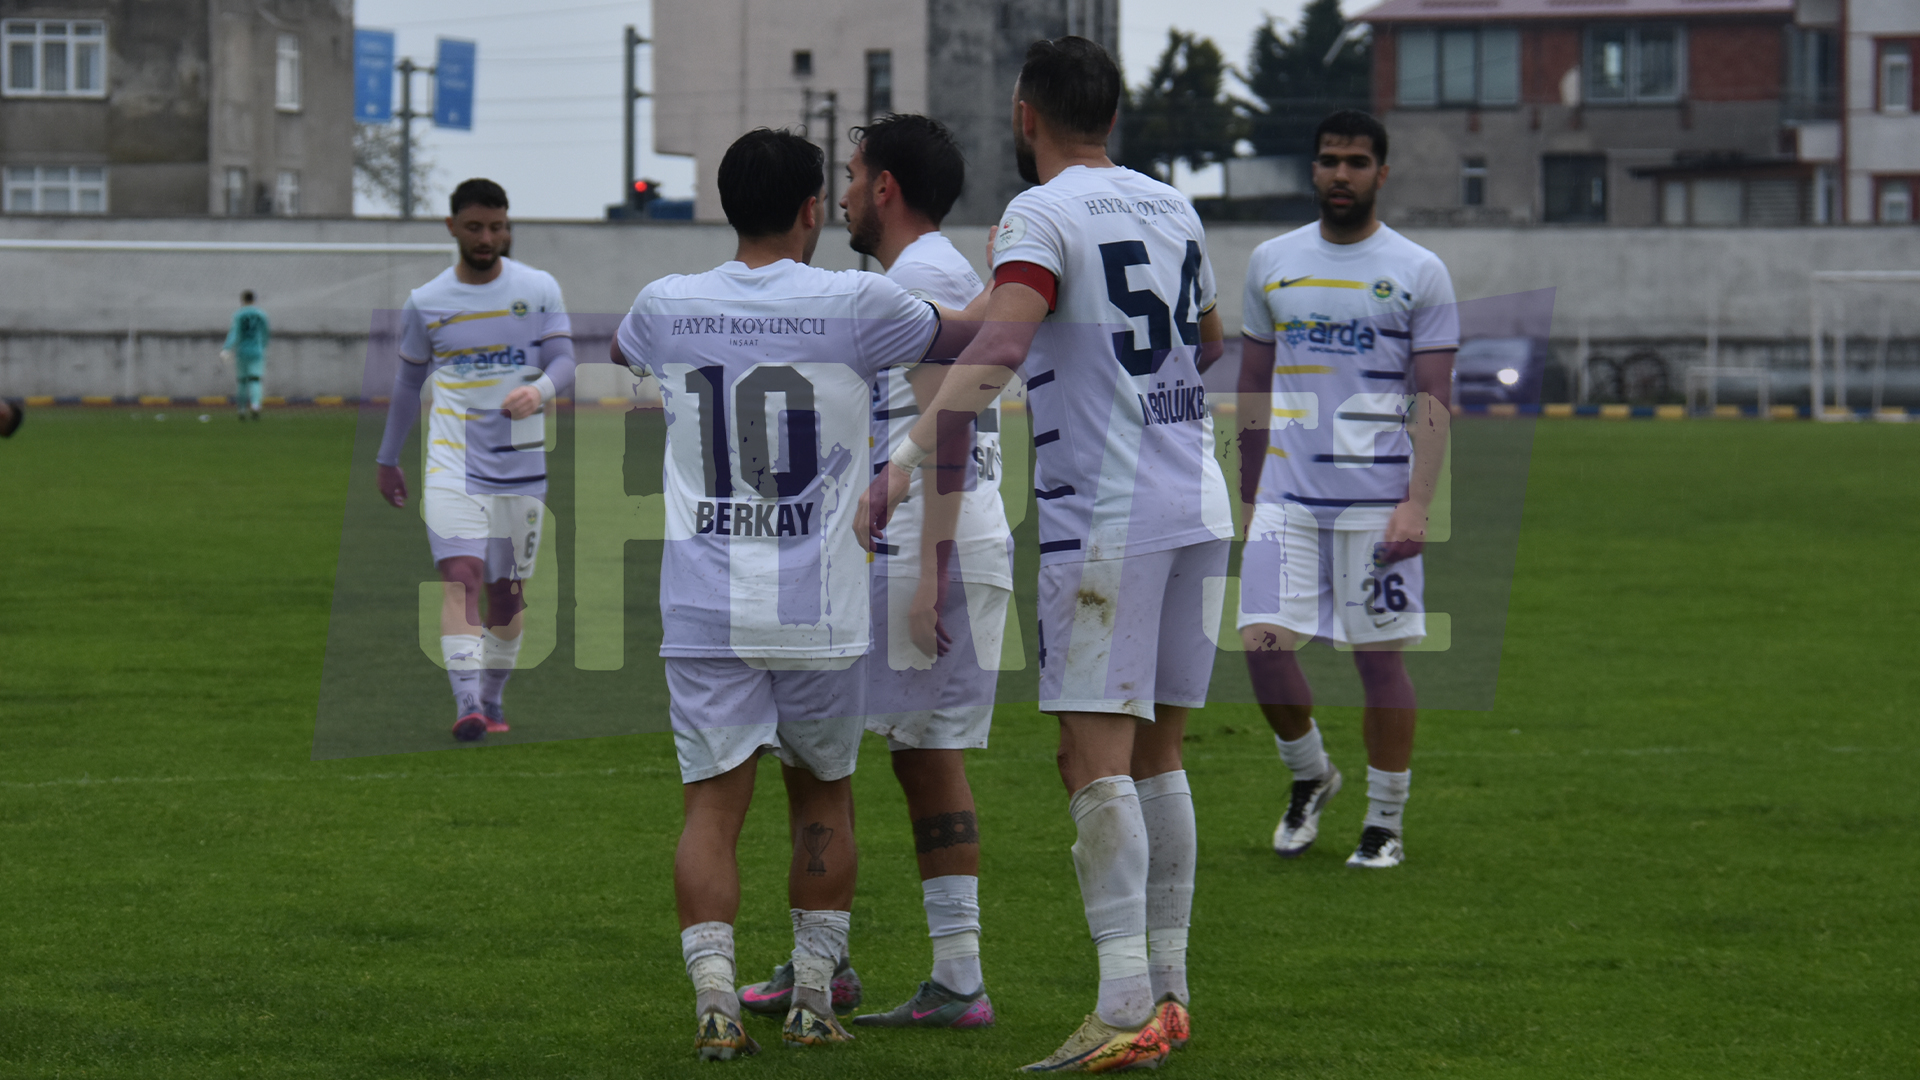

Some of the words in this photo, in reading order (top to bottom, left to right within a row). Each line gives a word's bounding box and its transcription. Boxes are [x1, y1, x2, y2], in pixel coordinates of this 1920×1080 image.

[1131, 199, 1187, 216] OYUNC
[1098, 239, 1202, 377] 54
[672, 313, 724, 335] HAYRİ
[730, 318, 825, 335] KOYUNCU
[1309, 319, 1376, 350] arda
[729, 337, 759, 346] İNŞAAT
[474, 345, 526, 370] arda
[685, 365, 818, 498] 10
[695, 502, 814, 536] BERKAY
[524, 531, 536, 559] 6
[1361, 573, 1407, 615] 26
